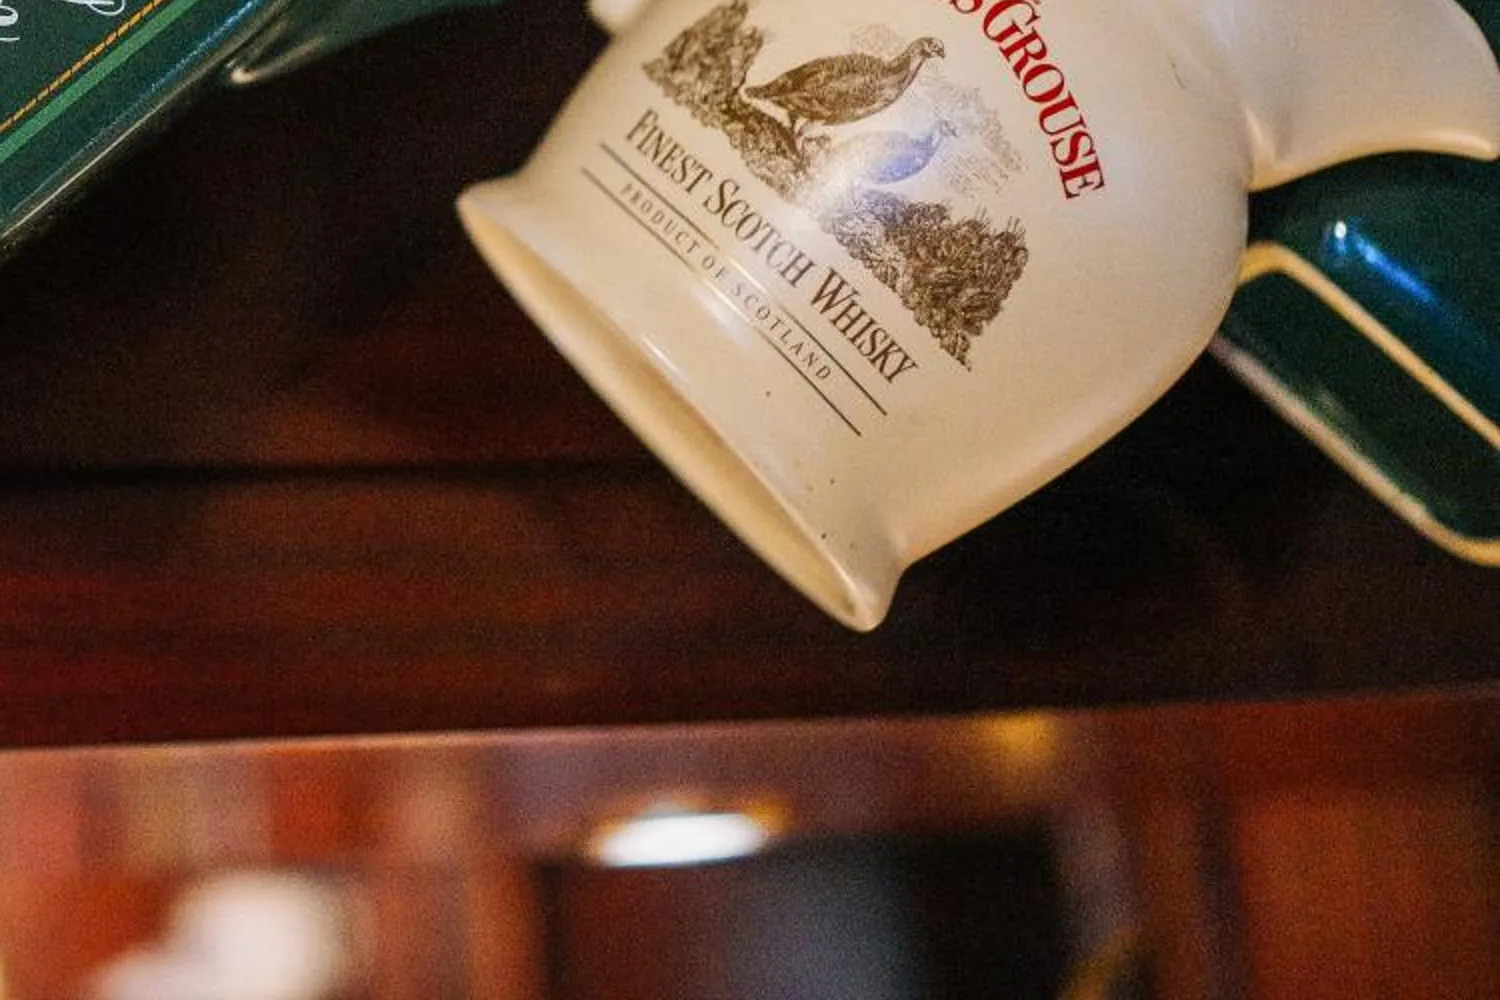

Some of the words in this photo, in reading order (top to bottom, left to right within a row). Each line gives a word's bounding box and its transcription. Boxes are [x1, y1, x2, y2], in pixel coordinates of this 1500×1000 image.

[619, 181, 701, 257] PRODUCT
[702, 254, 730, 283] OF
[729, 281, 833, 382] SCOTLAND
[625, 107, 713, 195] FINEST
[702, 178, 818, 290] SCOTCH
[810, 267, 921, 385] WHISKY
